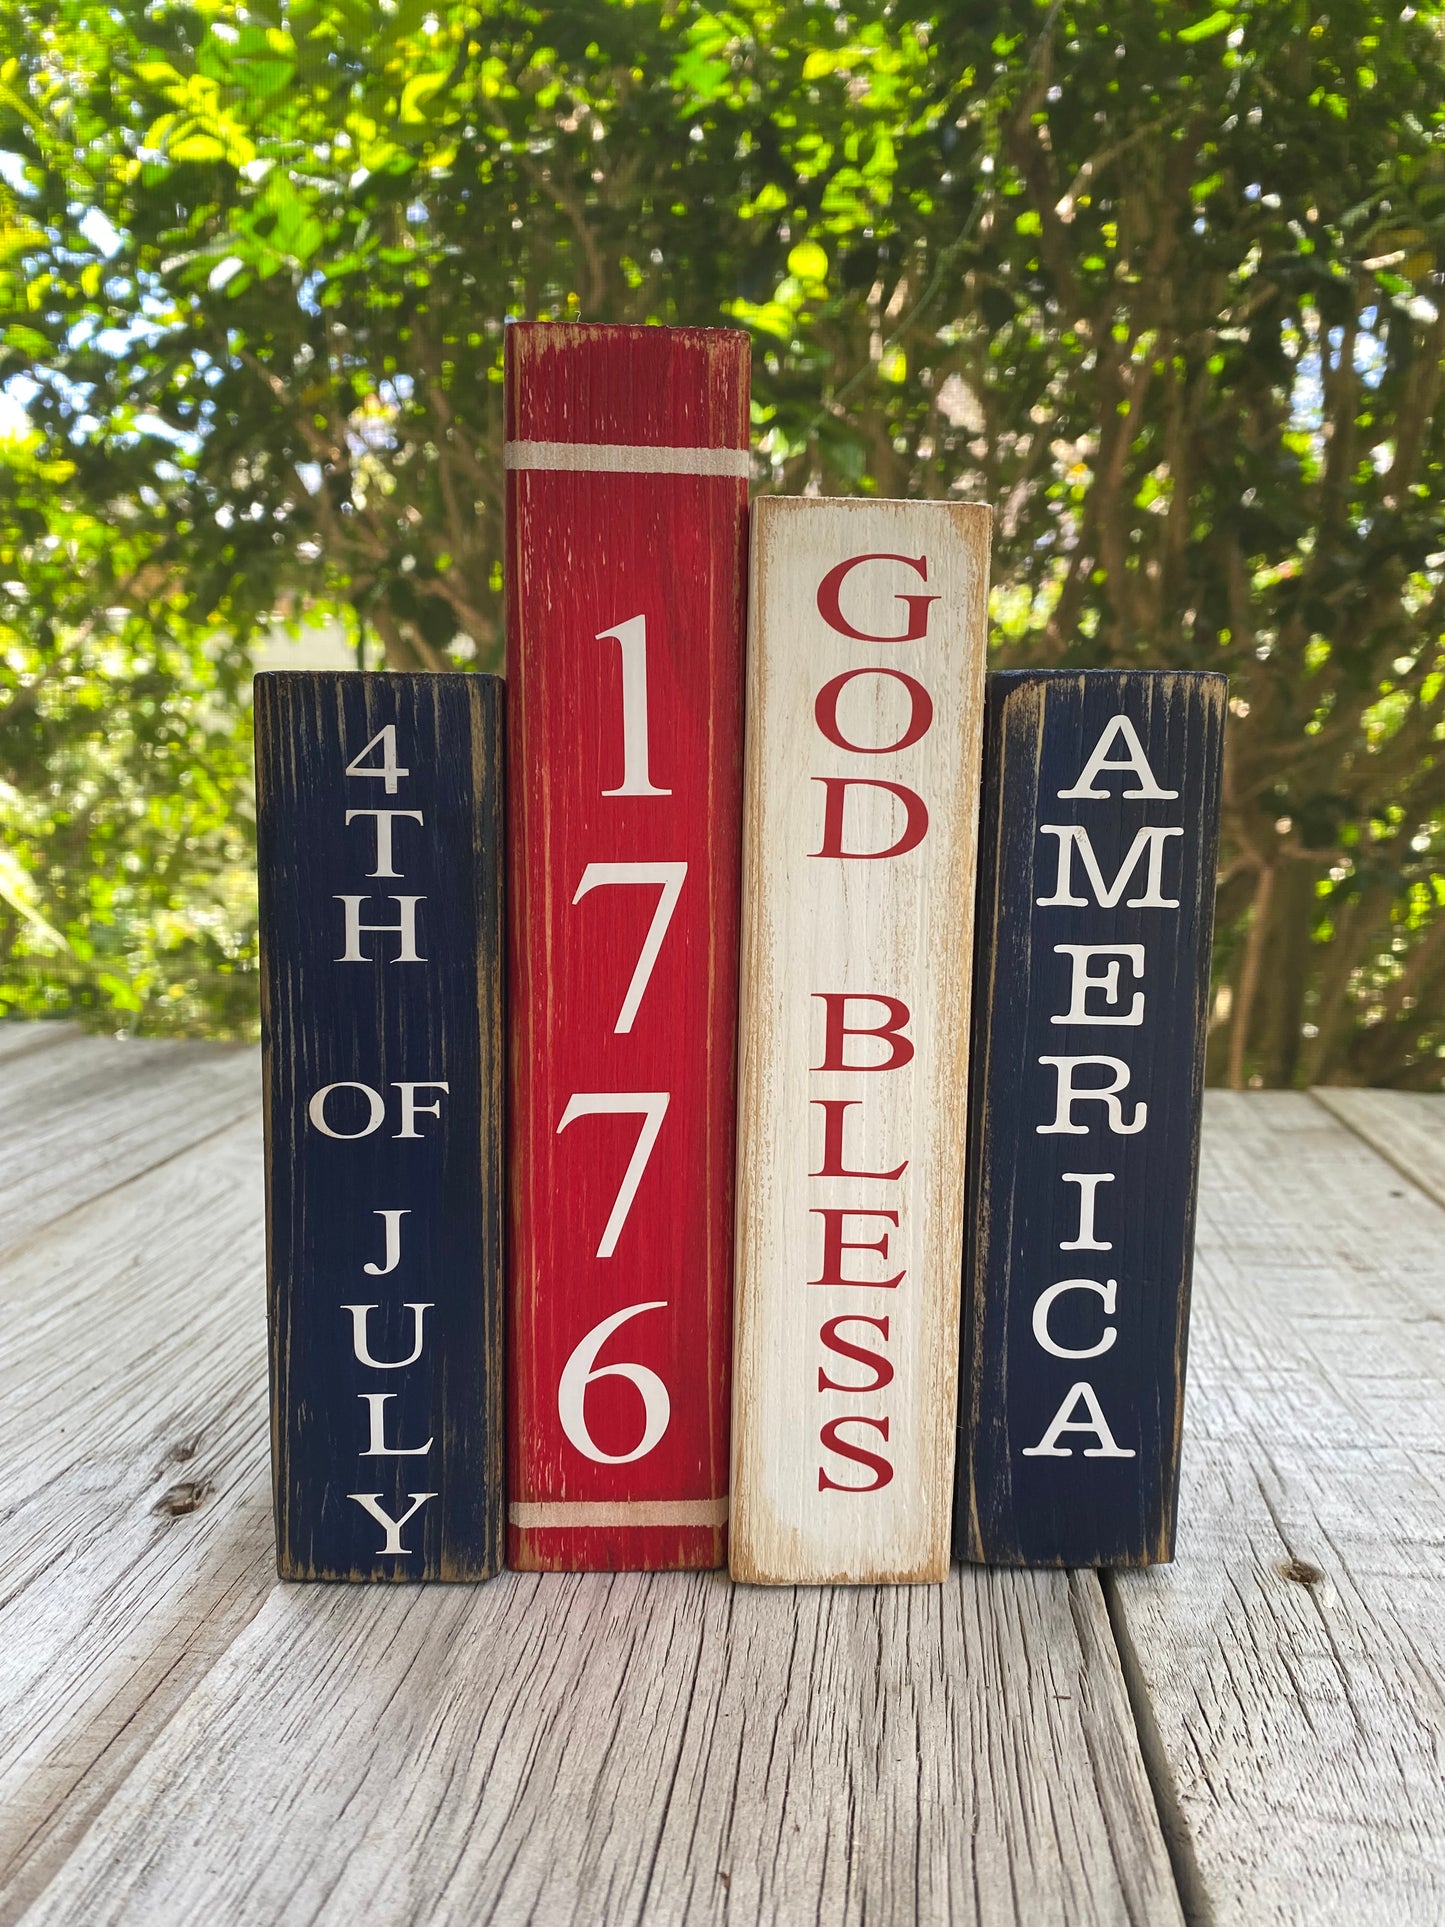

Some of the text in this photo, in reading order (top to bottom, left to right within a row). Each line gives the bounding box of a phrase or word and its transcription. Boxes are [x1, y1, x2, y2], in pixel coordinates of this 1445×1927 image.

[309, 724, 449, 1555] 4TH OF JULY
[557, 614, 688, 1465] 1776
[807, 553, 941, 1492] GOD BLESS
[1023, 714, 1184, 1459] AMERICA
